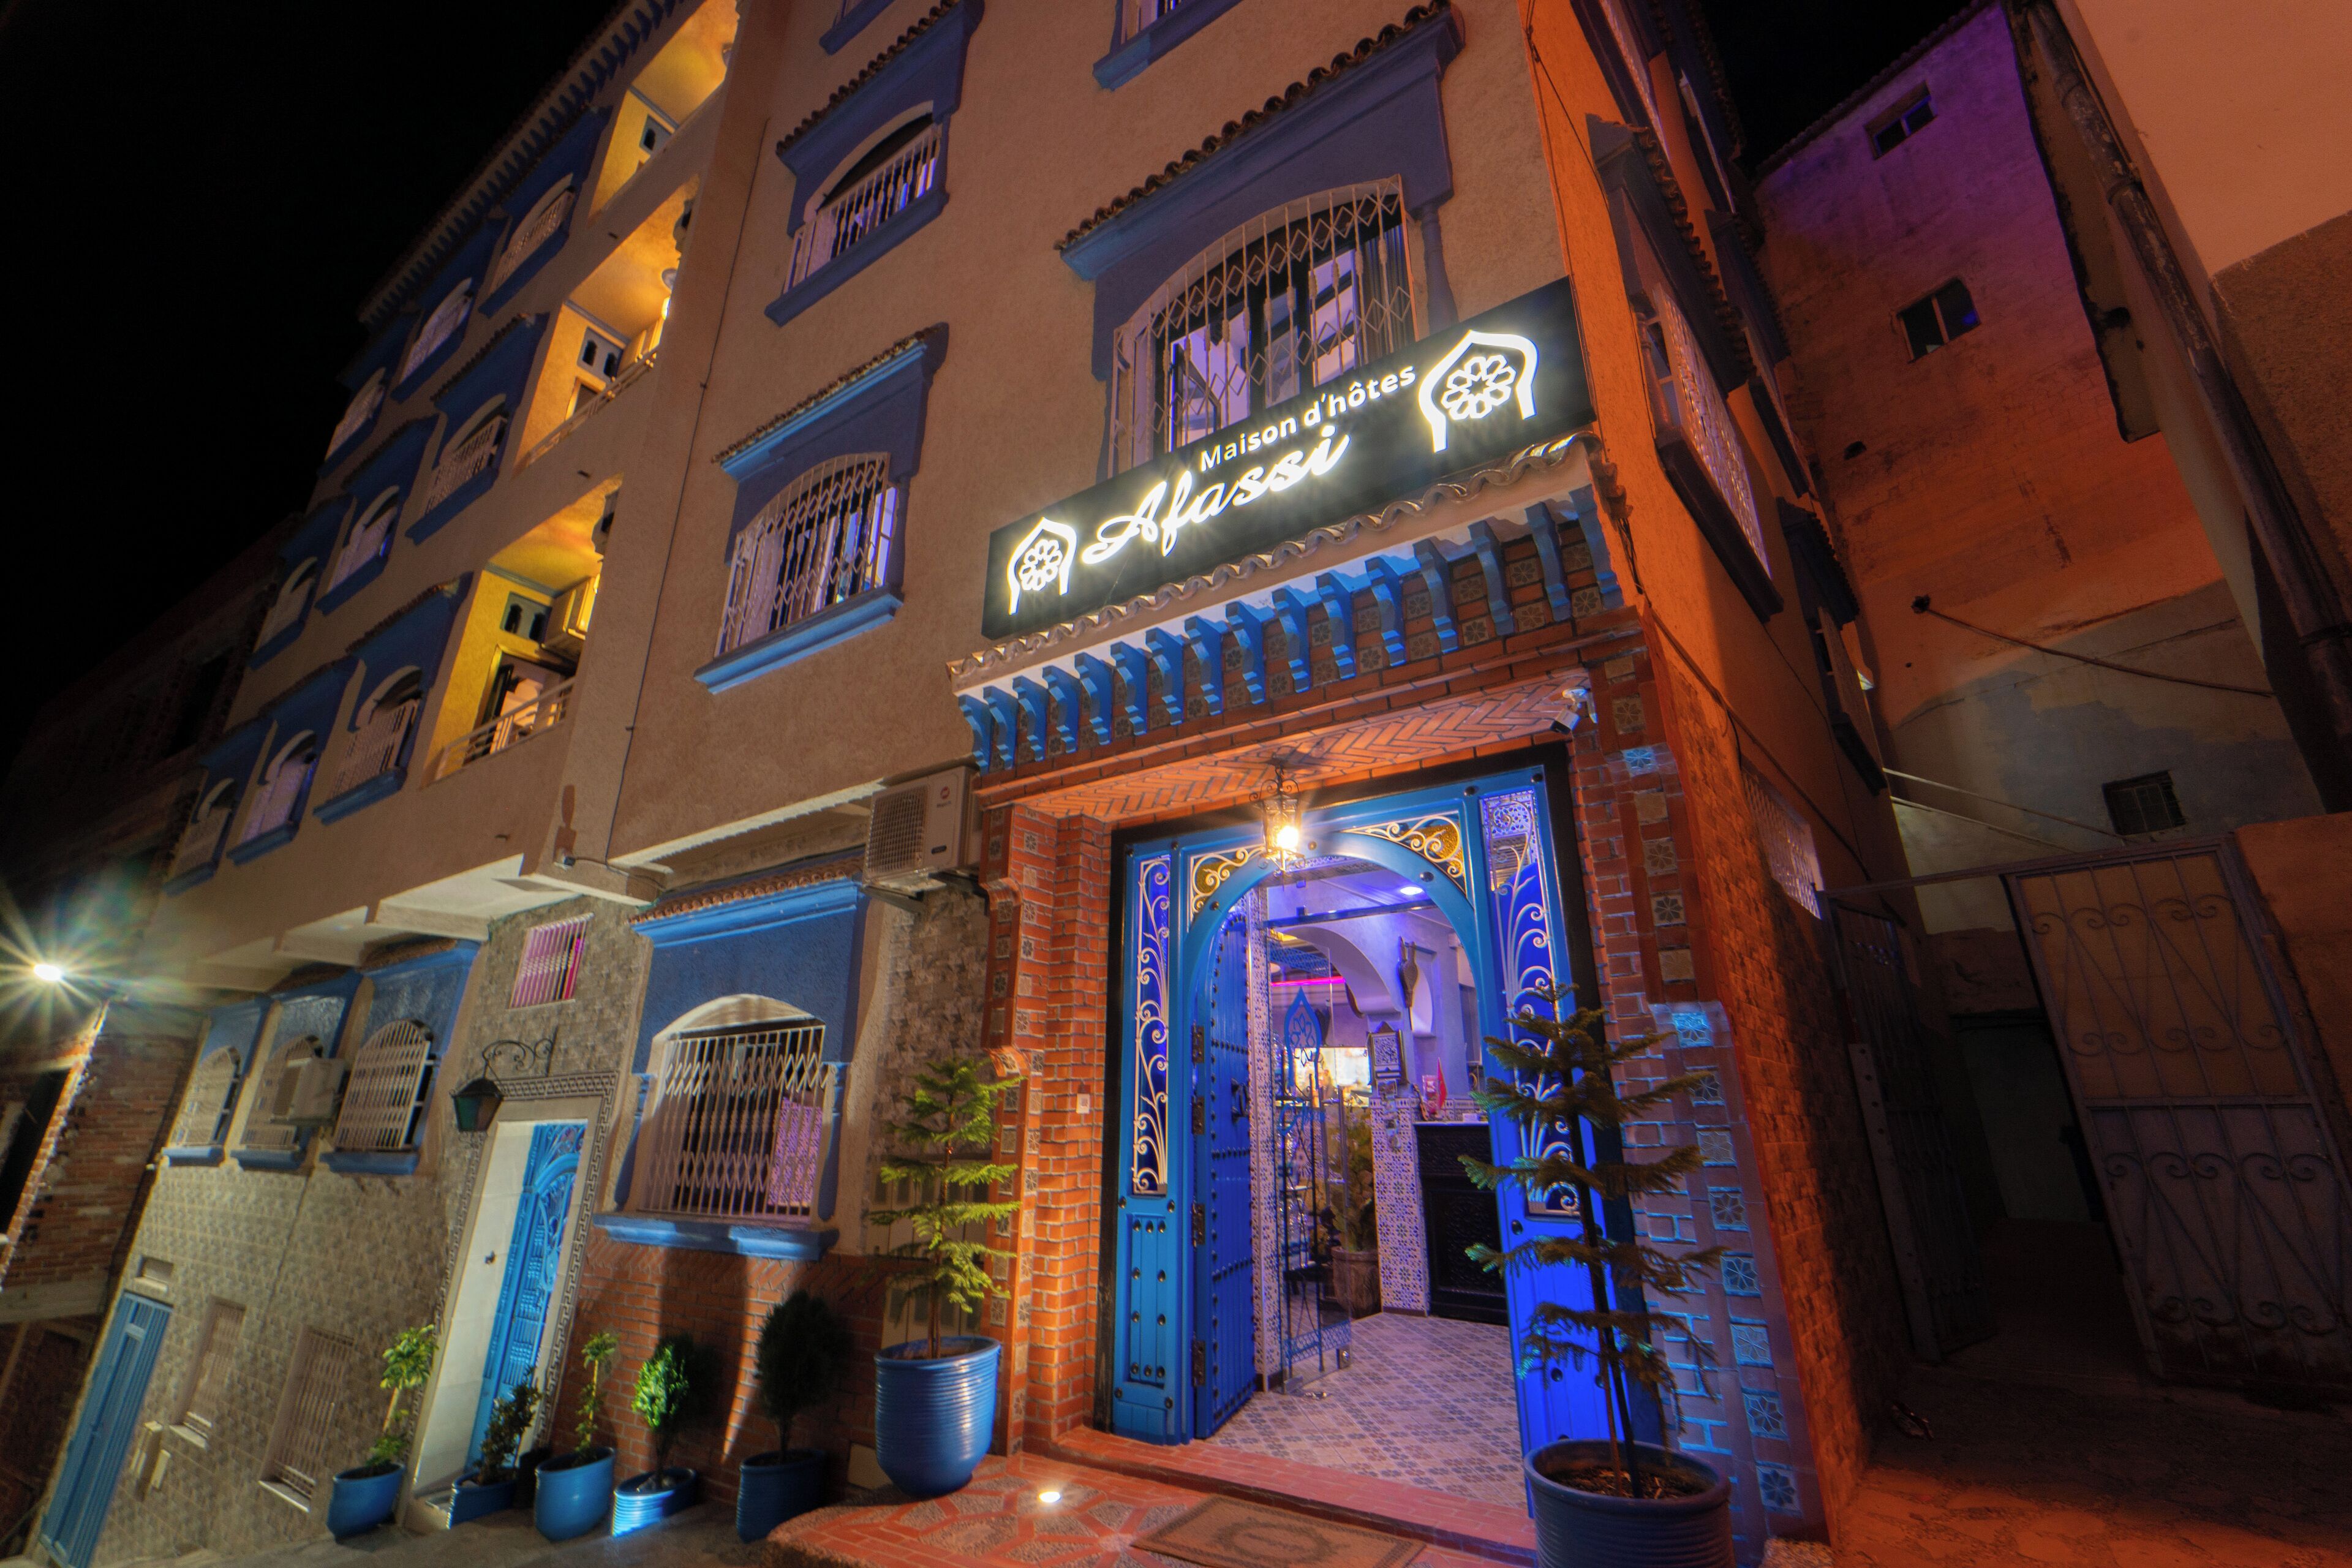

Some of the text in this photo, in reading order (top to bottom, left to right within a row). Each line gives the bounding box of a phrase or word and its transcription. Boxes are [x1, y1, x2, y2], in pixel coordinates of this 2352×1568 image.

[1199, 365, 1417, 472] Maison d'hôtes
[1081, 425, 1351, 564] Afassi
